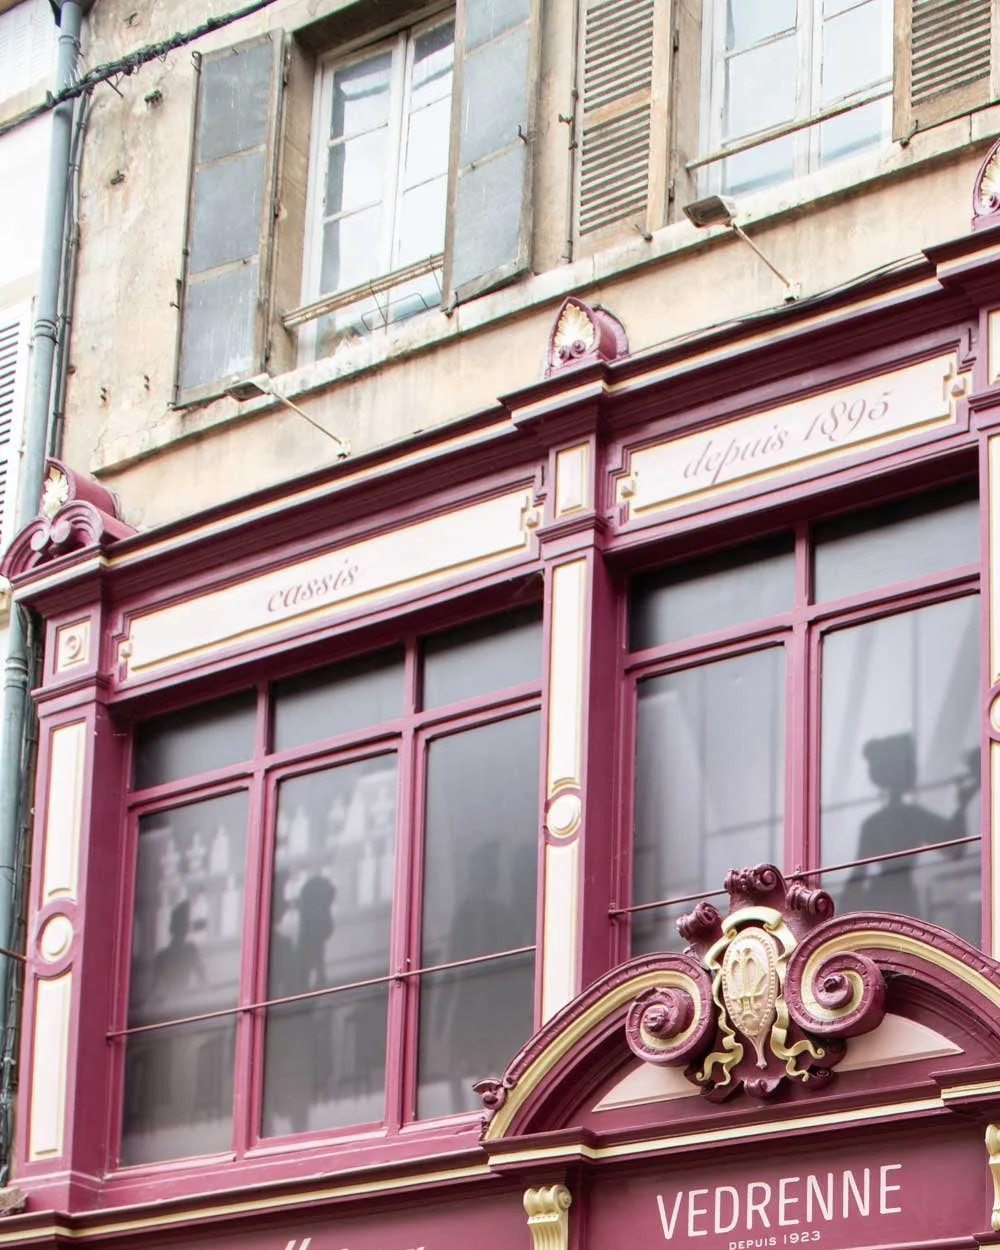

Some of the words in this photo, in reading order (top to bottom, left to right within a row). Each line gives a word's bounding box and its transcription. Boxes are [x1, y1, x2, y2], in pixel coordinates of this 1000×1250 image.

[683, 425, 789, 485] depuis
[804, 391, 894, 442] 1895
[267, 558, 359, 612] cassis
[656, 1163, 903, 1240] VEDRENNE
[728, 1236, 777, 1250] DEPUIS
[783, 1230, 821, 1245] 1923
